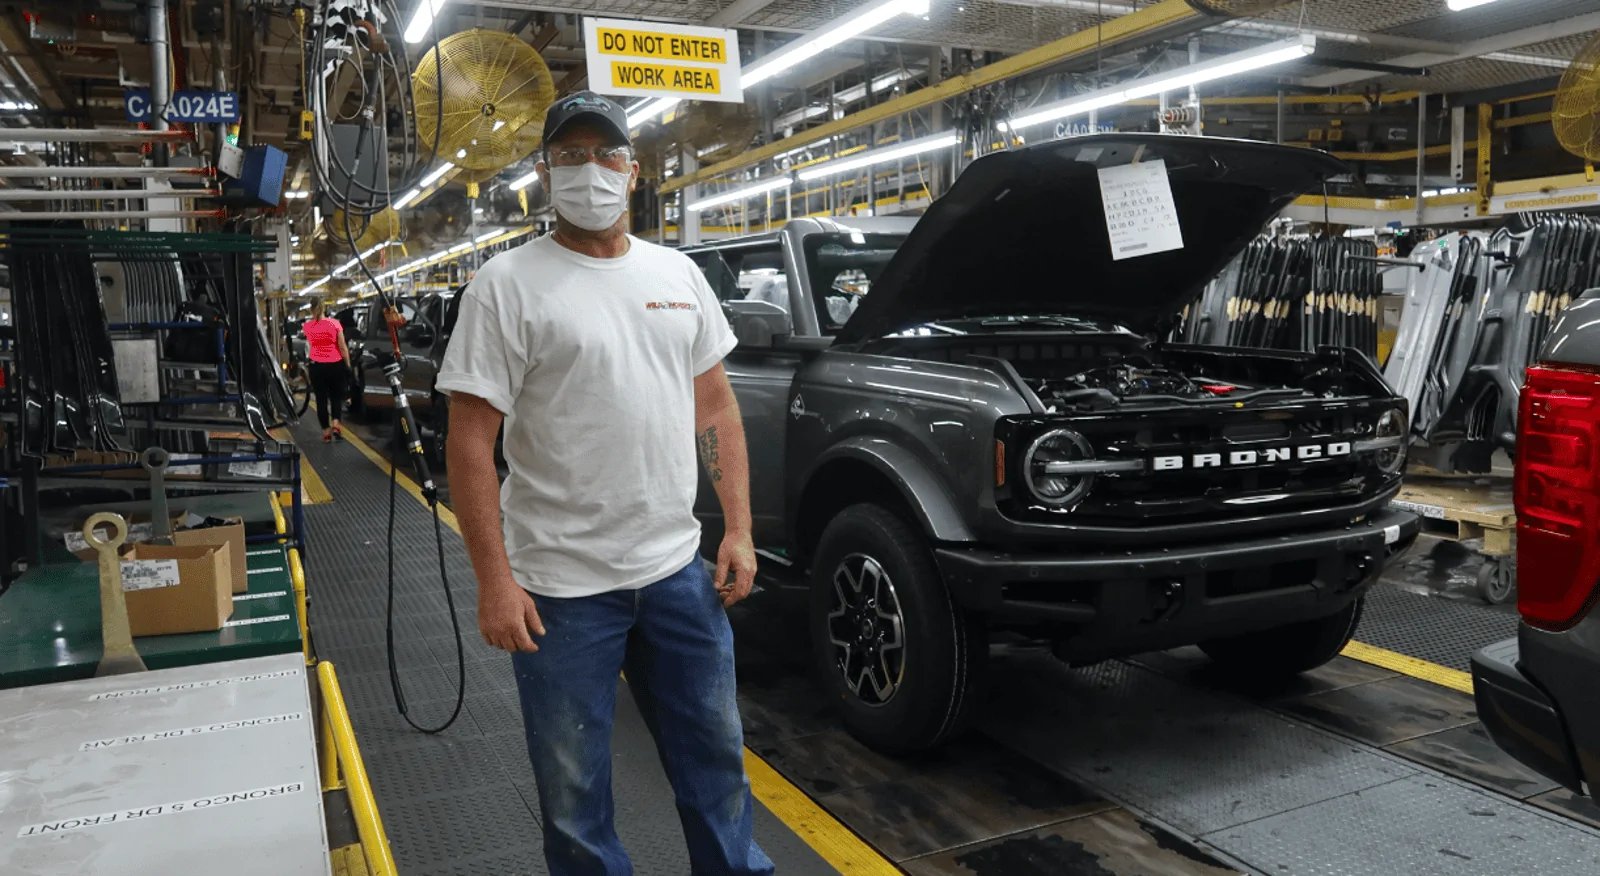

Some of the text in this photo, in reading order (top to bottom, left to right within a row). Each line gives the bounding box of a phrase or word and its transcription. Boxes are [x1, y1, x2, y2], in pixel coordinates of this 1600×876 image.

[603, 32, 721, 60] DO NOT ENTER
[617, 65, 715, 90] WORK AREA
[127, 95, 236, 118] CA024E
[1153, 442, 1351, 471] BRONCO
[154, 729, 184, 740] DR
[209, 713, 301, 732] BRONCO
[84, 735, 145, 750] REAR
[22, 783, 302, 837] BRONCO 5 DR FRONT
